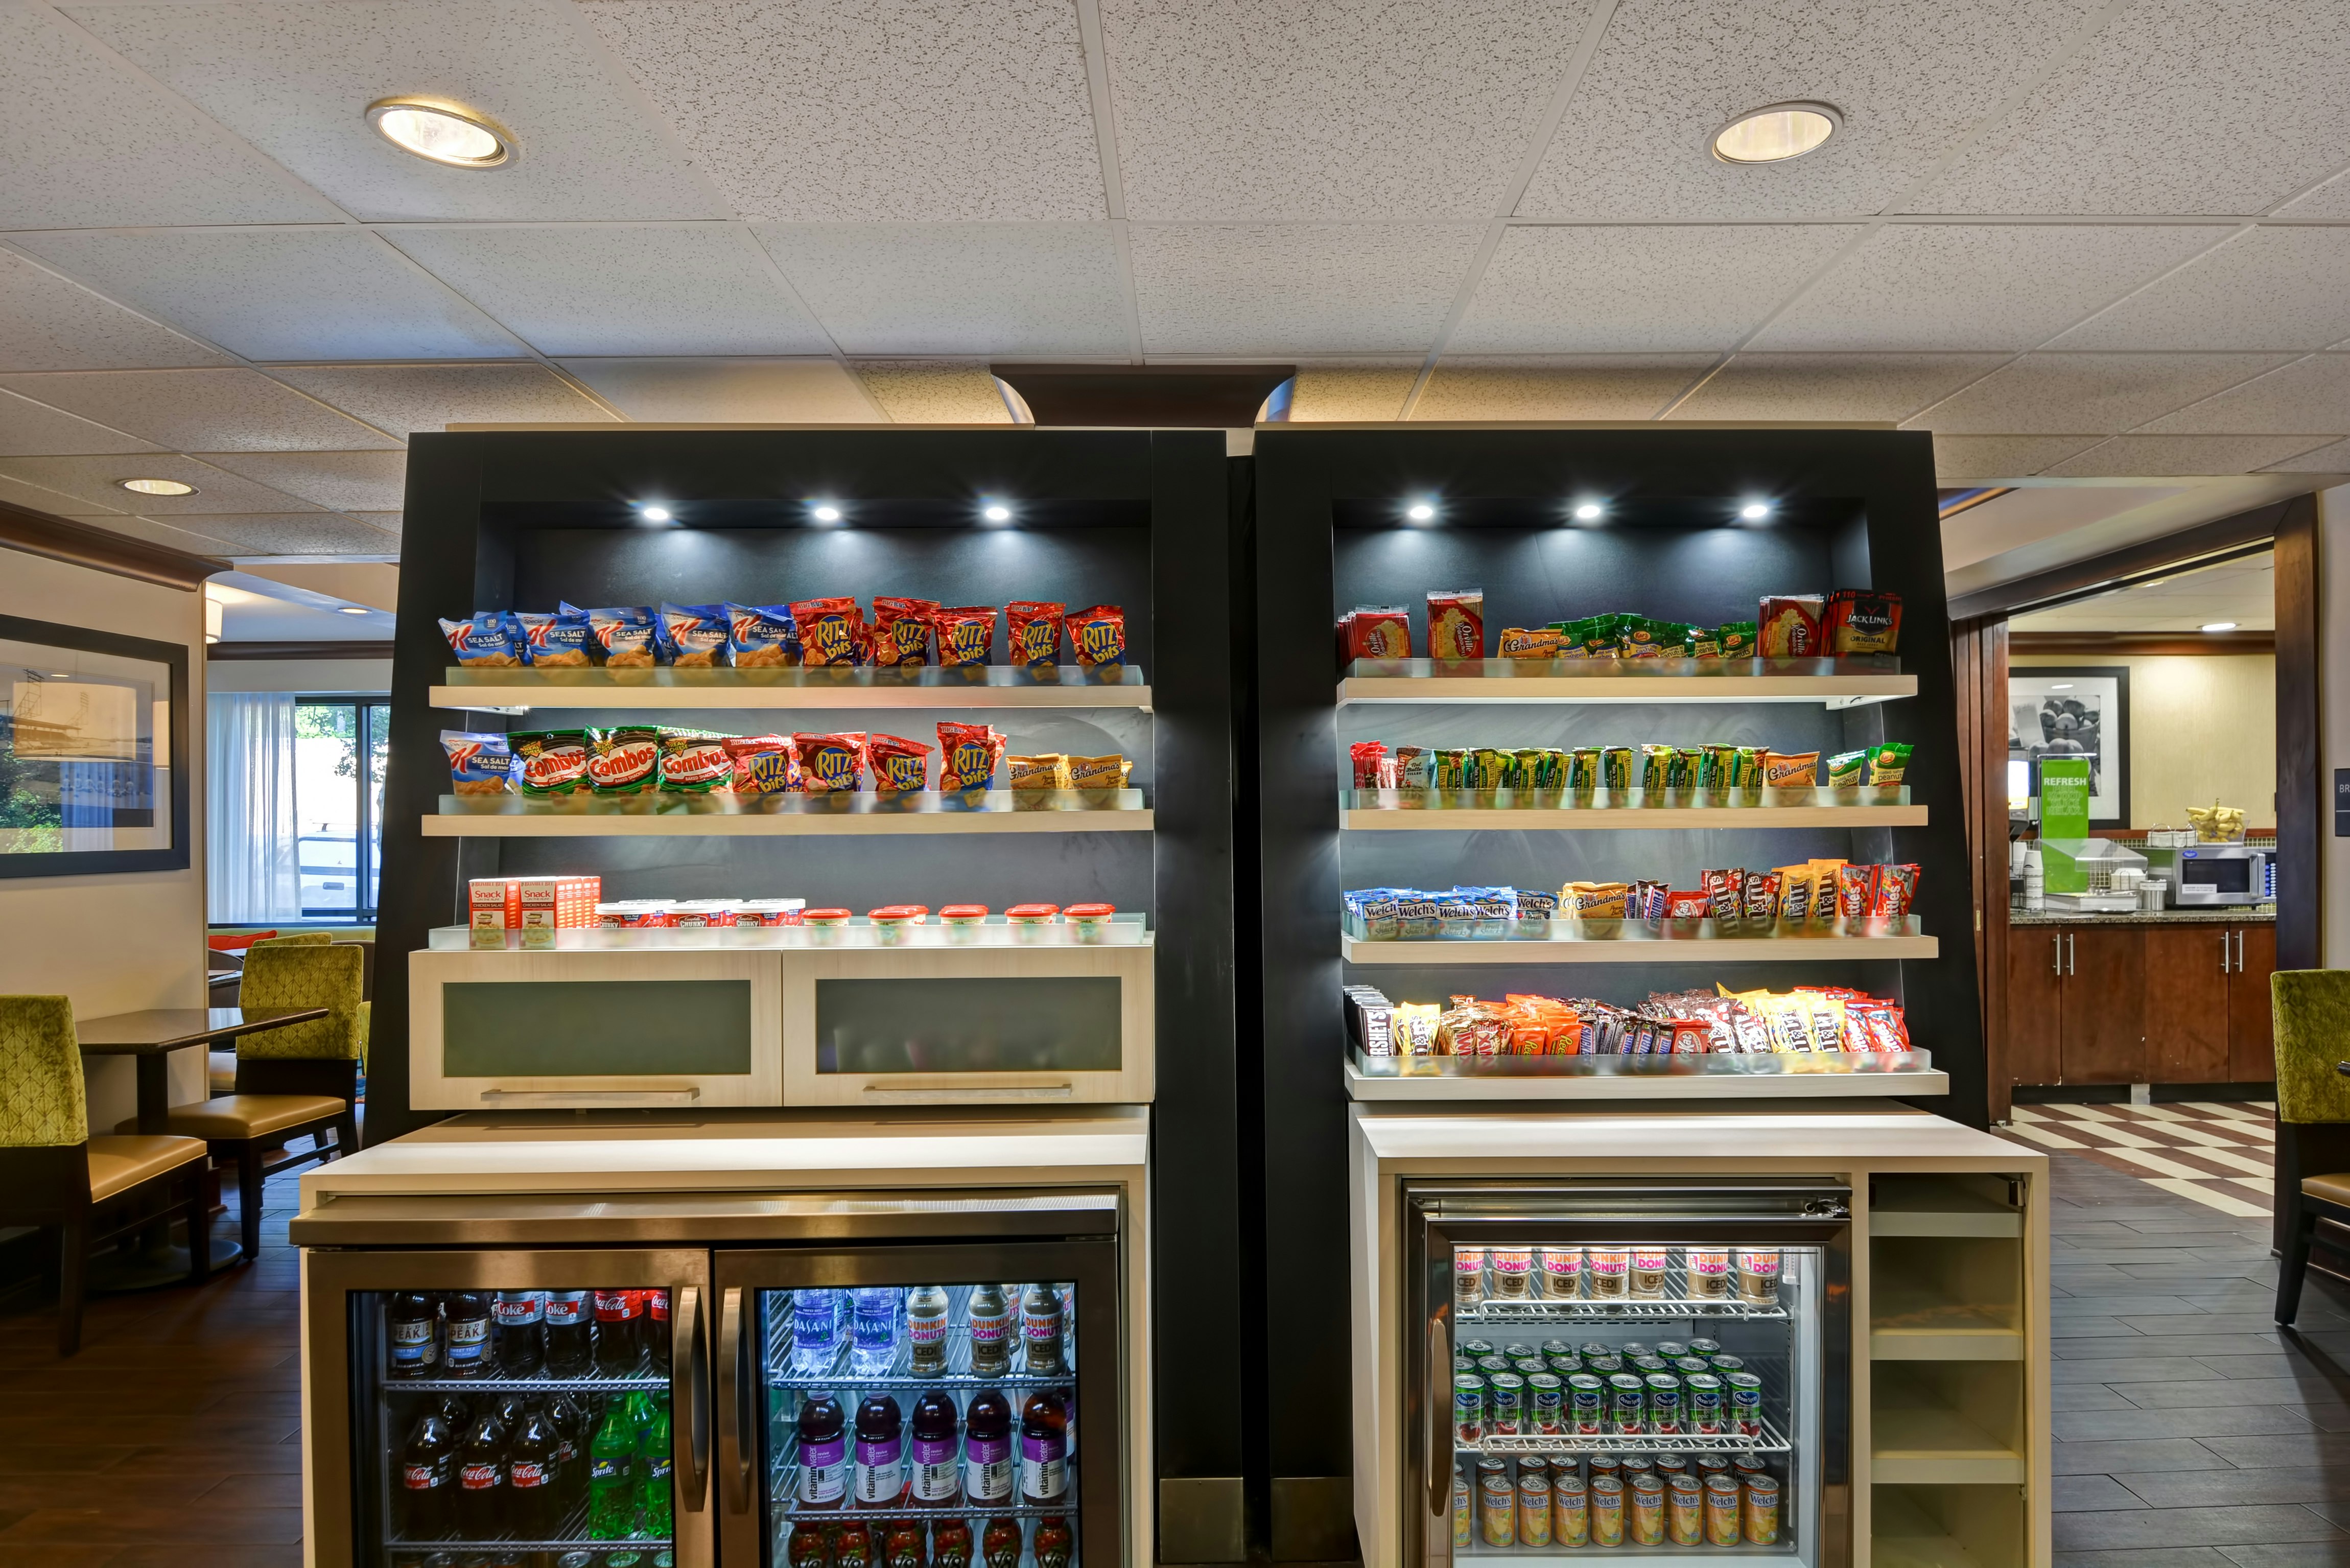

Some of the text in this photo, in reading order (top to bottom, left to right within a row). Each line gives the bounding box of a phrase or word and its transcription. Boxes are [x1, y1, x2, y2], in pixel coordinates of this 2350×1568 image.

[1846, 614, 1868, 623] JACK
[486, 634, 503, 642] SALT
[816, 620, 849, 648] RITZ
[892, 621, 926, 646] RITZ
[951, 624, 985, 650] RITZ
[1022, 623, 1053, 650] RITZ
[1082, 625, 1118, 653] RITZ
[1462, 625, 1473, 652] Orville
[898, 641, 924, 655] bits
[1508, 638, 1558, 652] Grandma's
[1797, 628, 1807, 654] Orville
[825, 641, 852, 659] bits
[958, 644, 984, 661] bits
[1027, 644, 1053, 661] bits
[1093, 645, 1120, 662] bits
[590, 747, 655, 778] Combos
[663, 749, 730, 775] Combos
[750, 754, 785, 777] RITZ
[816, 753, 852, 777] RITZ
[887, 756, 922, 781] RITZ
[953, 748, 988, 776] RITZ
[960, 769, 989, 785] bits
[1071, 762, 1120, 780] Grandma's
[759, 776, 787, 792] bits
[825, 771, 854, 788] bits
[898, 776, 925, 791] bits
[2044, 778, 2087, 786] REFRESH
[524, 890, 551, 898] Snack
[1517, 896, 1552, 910] Welch's
[1576, 893, 1626, 910] Grandma's
[1367, 904, 1396, 918] Welch
[1399, 905, 1435, 918] Welch's
[1439, 907, 1475, 918] Welch's
[1475, 905, 1510, 917] Welch's
[1590, 1259, 1627, 1273] DONUTS
[498, 1302, 525, 1316] Coke
[545, 1302, 569, 1316] Coke
[794, 1319, 832, 1334] DASANI
[854, 1319, 891, 1335] DASANI
[908, 1327, 946, 1340] DONUTS
[450, 1329, 480, 1339] PEAK
[1457, 1395, 1478, 1405] Ocean Spray
[1494, 1393, 1504, 1403] Ocean
[1537, 1395, 1559, 1405] Ocean Spray
[1576, 1395, 1597, 1405] Ocean Spray
[1620, 1396, 1641, 1405] Ocean Spray
[1657, 1395, 1677, 1405] Ocean Spray
[1697, 1395, 1718, 1405] Ocean Spray
[1736, 1394, 1757, 1403] Ocean Spray
[461, 1464, 498, 1481] Coca-Cola
[592, 1465, 614, 1479] Sprite
[652, 1465, 671, 1478] Spri
[1485, 1495, 1511, 1506] Welch's
[1521, 1495, 1548, 1506] Welch's
[1558, 1495, 1585, 1506] Welch's
[1593, 1495, 1620, 1506] Welch's
[1635, 1494, 1661, 1506] Welch's
[1672, 1494, 1699, 1505] Welch's
[1709, 1495, 1736, 1506] Welch's
[1750, 1493, 1778, 1504] Welch's
